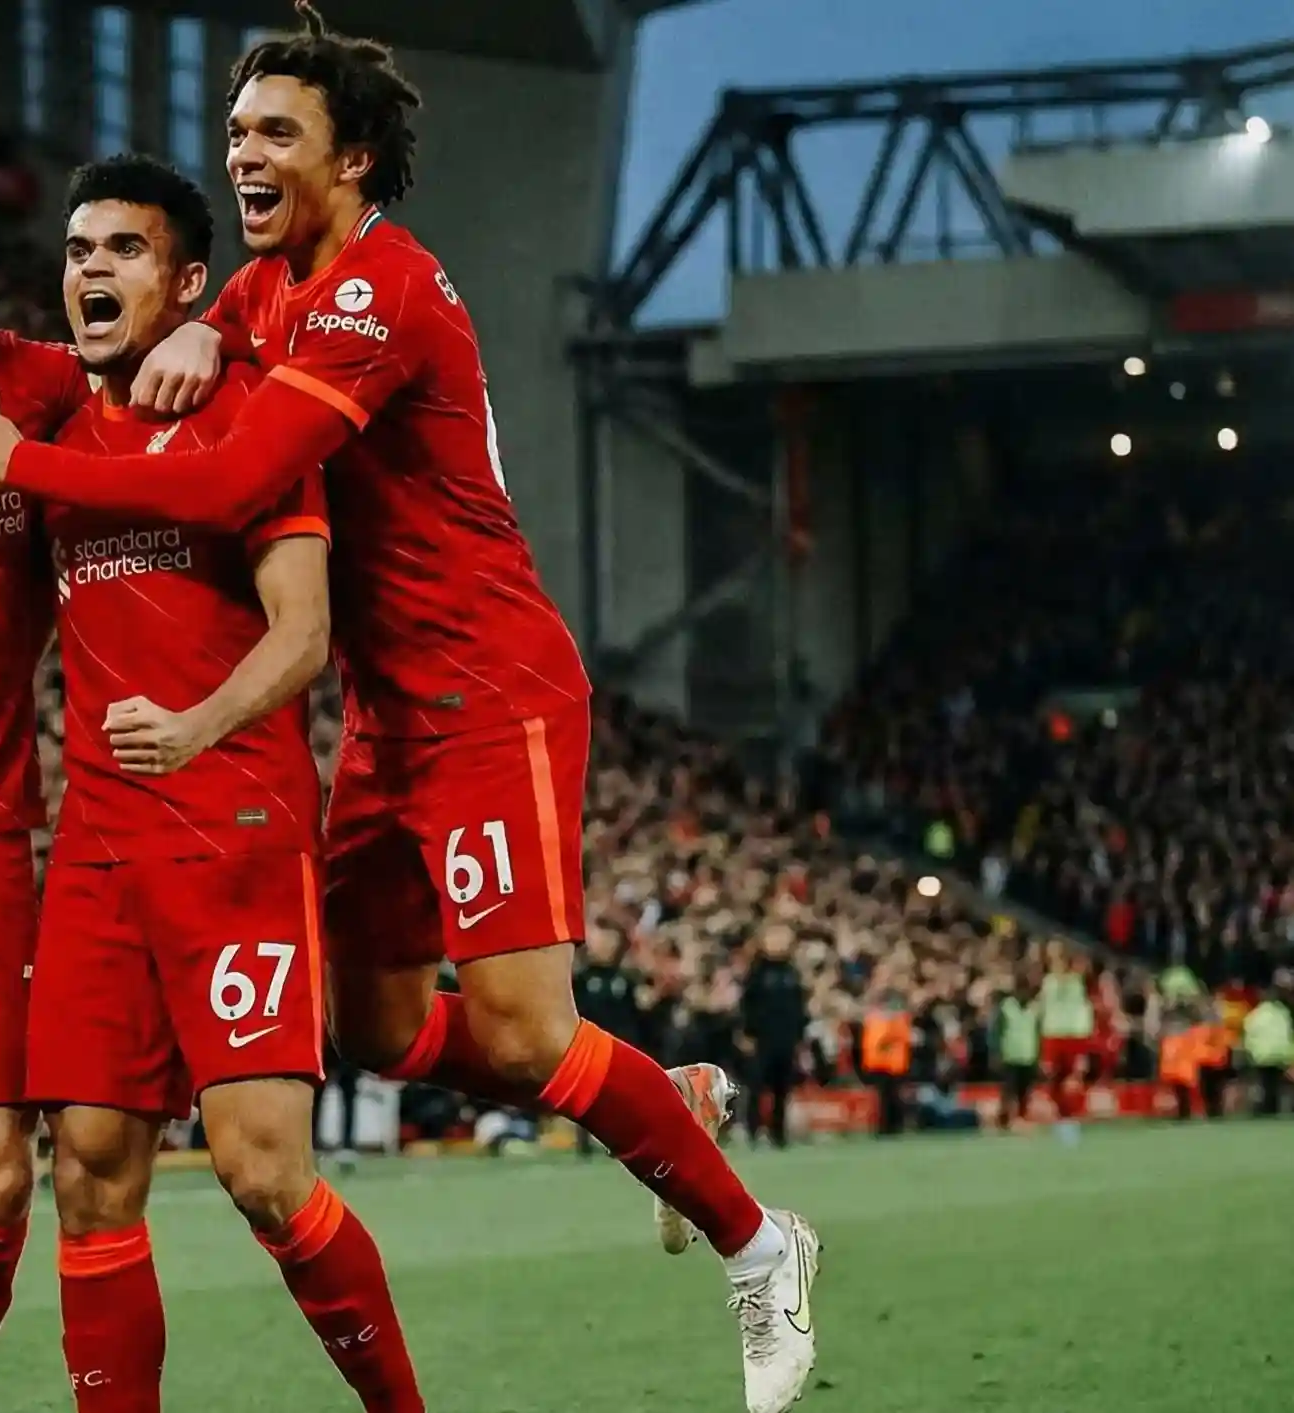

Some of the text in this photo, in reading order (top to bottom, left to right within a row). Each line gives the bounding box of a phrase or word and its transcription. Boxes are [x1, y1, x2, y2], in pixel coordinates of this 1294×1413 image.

[306, 310, 390, 343] Expedia
[74, 526, 181, 562] standard
[75, 546, 192, 585] chartered
[445, 820, 514, 904] 61
[210, 941, 296, 1021] 67
